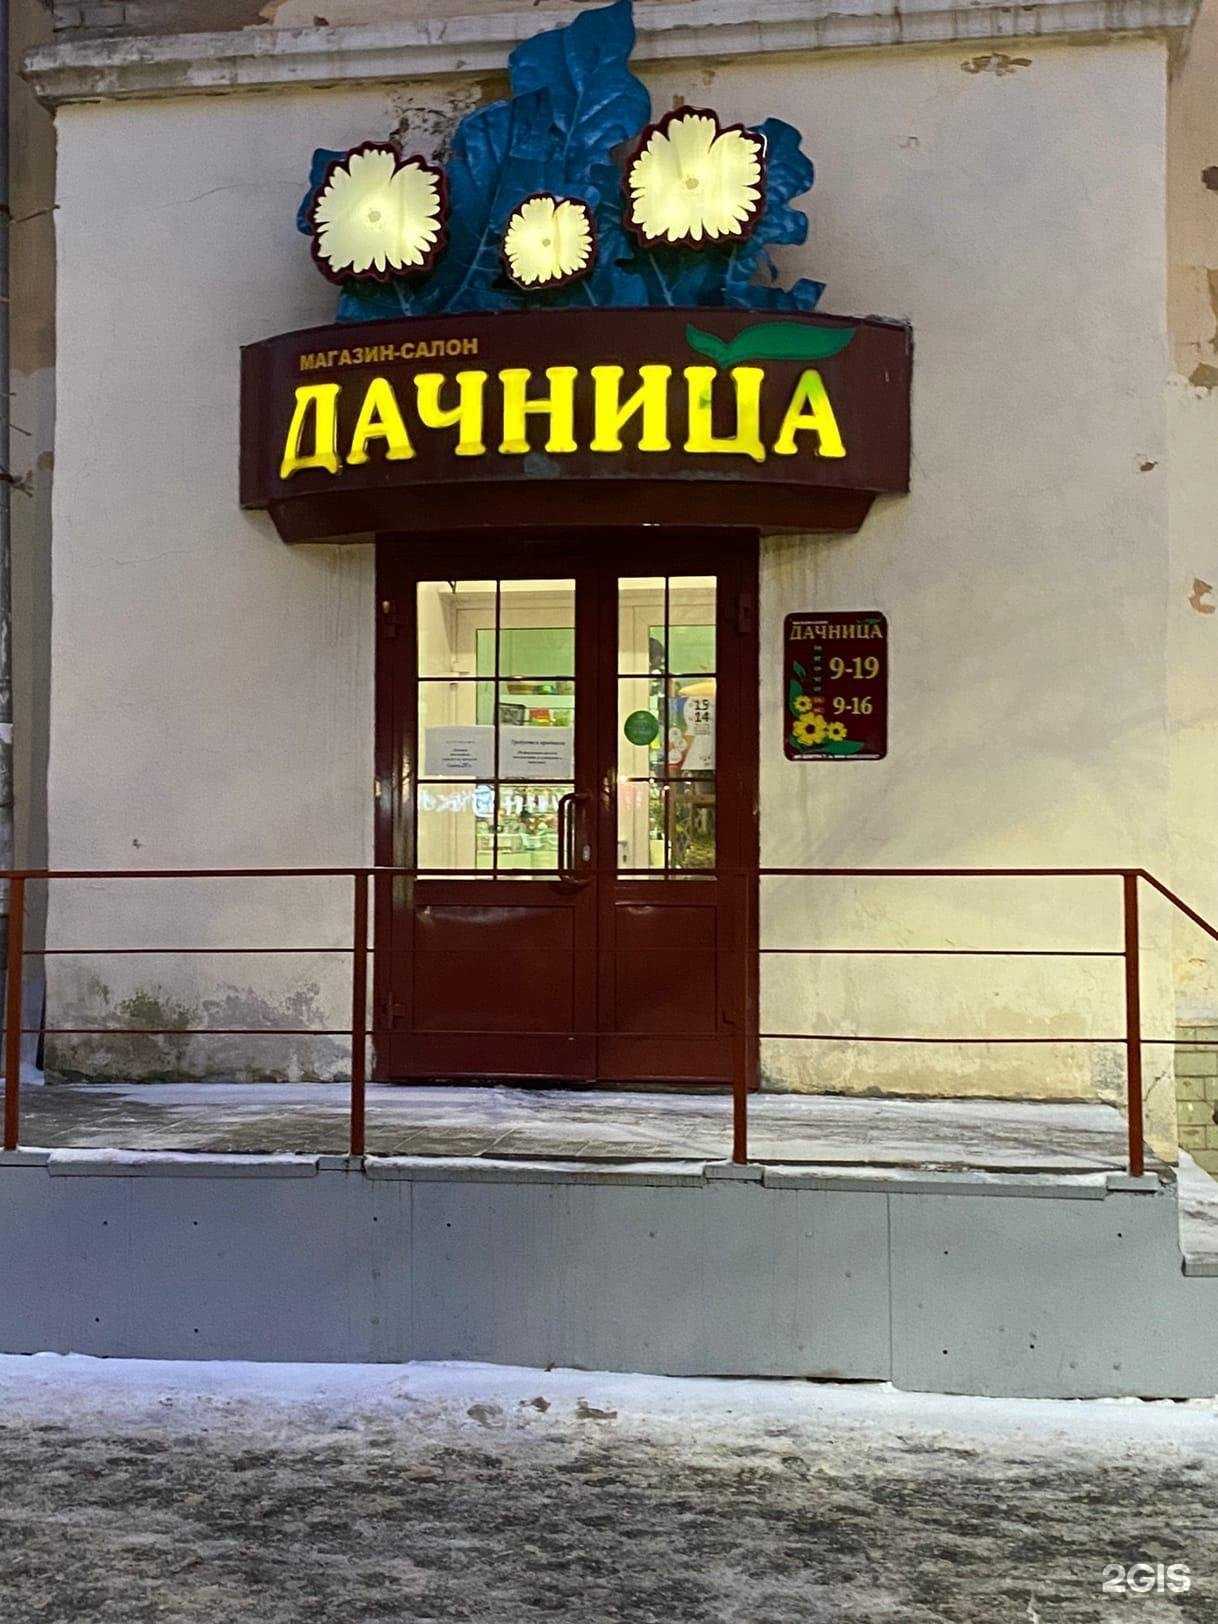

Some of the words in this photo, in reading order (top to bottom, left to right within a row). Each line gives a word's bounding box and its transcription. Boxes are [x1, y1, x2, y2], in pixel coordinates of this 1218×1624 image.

[299, 338, 478, 371] МАГАЗИН-САЛОН
[280, 365, 847, 479] ДАЧНИЦА
[790, 624, 883, 640] ДАЧНИЦА
[829, 656, 880, 680] 9-19
[832, 696, 873, 715] 9-16
